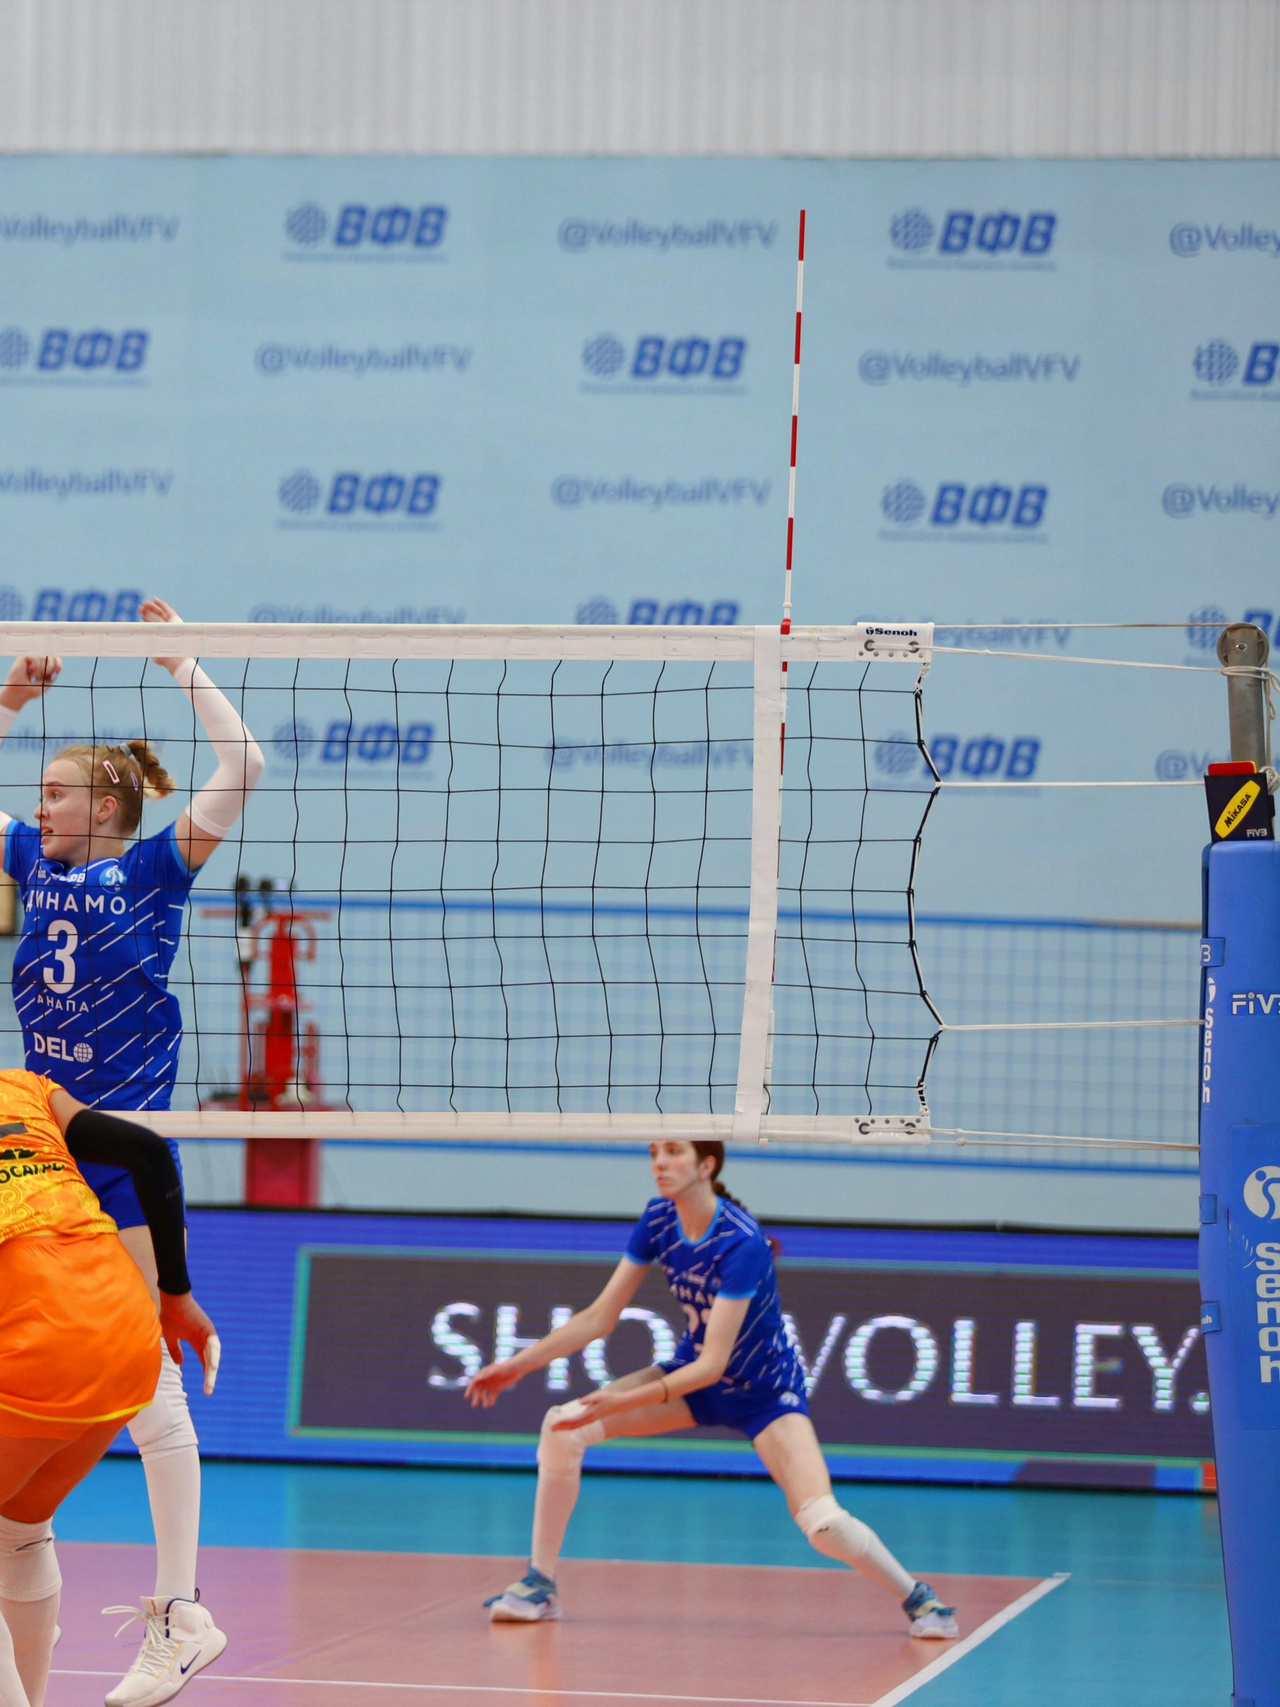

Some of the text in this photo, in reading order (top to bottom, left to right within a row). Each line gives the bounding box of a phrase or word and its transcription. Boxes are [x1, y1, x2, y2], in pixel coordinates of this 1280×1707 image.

[333, 202, 449, 249] ВФВ
[558, 216, 777, 253] @VolleyballVFV
[937, 208, 1058, 257] ВФВ
[36, 328, 150, 373] ВФВ
[255, 341, 472, 376] @VolleyballVFV
[630, 335, 748, 382] ВФВ
[858, 350, 1081, 387] @VolleyballVFV
[326, 471, 442, 519] ВФВ
[551, 474, 770, 508] @VolleyballVFV
[928, 482, 1050, 530] ВФВ
[875, 627, 917, 637] Senoh
[322, 718, 436, 767] ВФВ
[922, 731, 1043, 782] ВФВ
[43, 918, 79, 995] 3
[37, 994, 90, 1013] АНАПА
